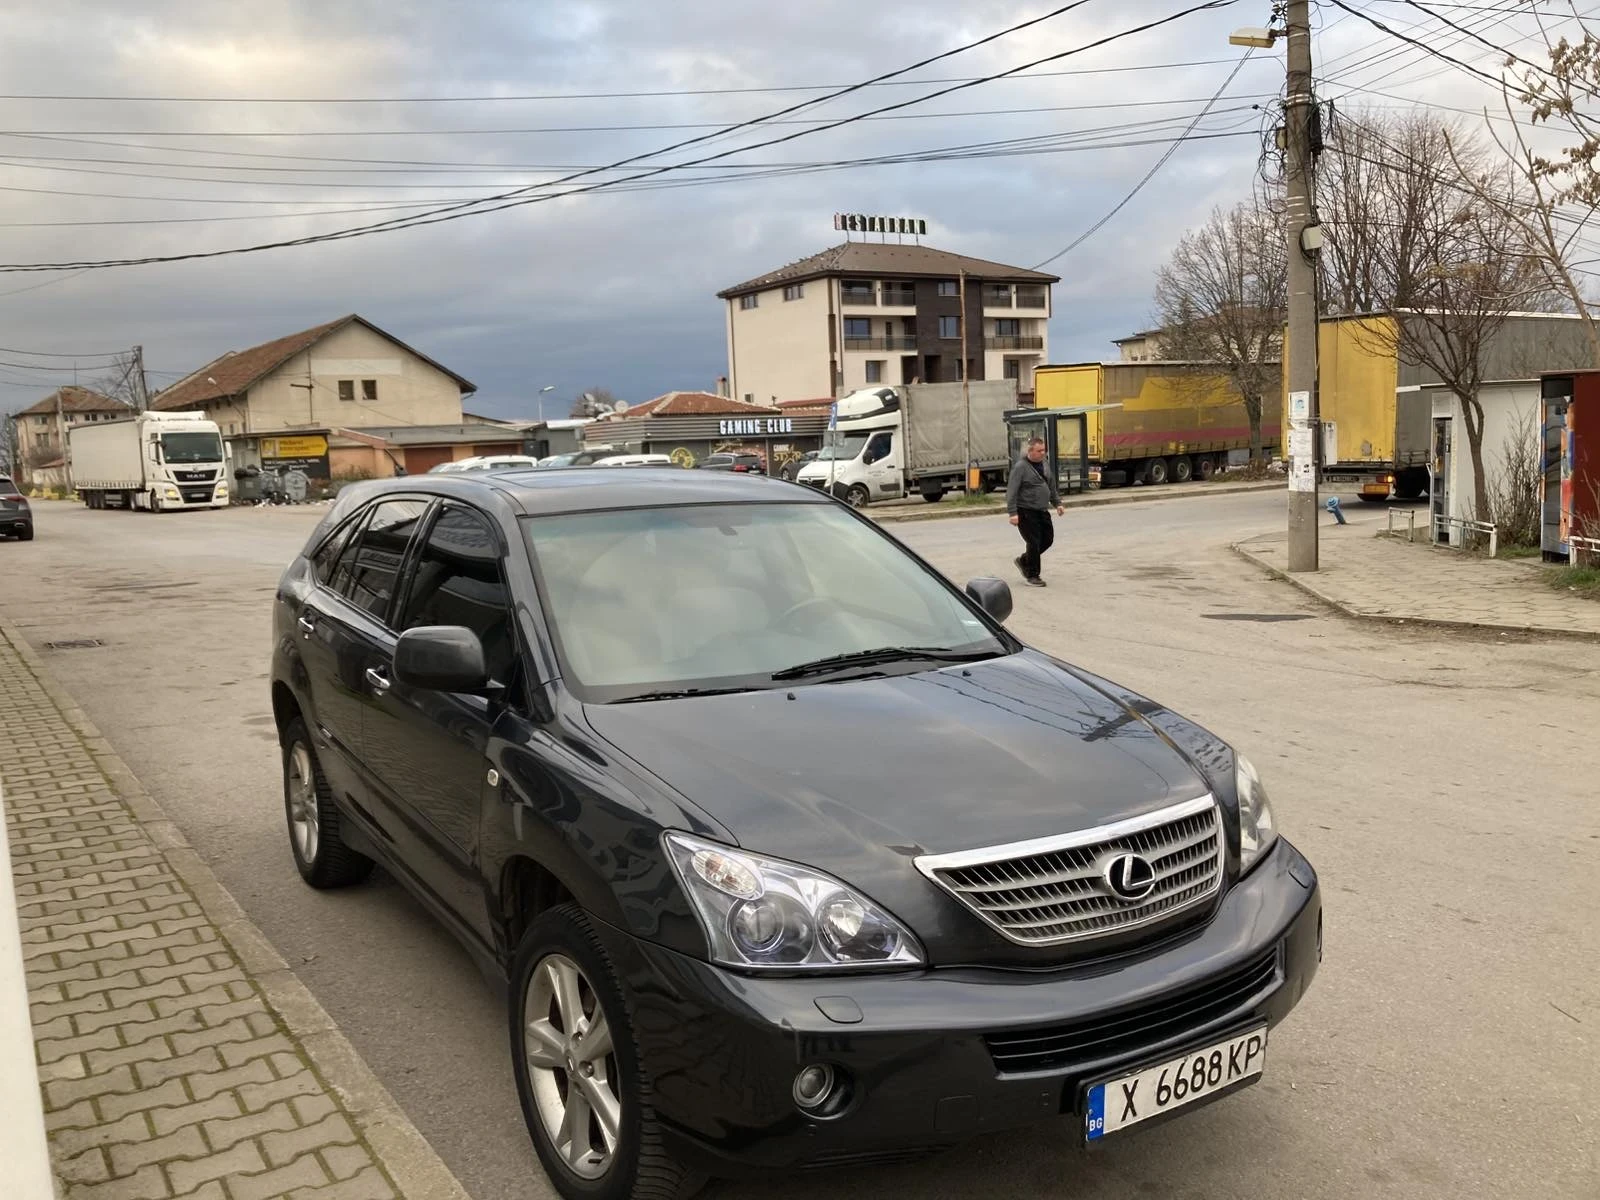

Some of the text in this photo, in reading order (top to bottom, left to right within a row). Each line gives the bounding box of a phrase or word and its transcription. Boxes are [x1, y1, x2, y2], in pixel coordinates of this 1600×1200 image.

[833, 213, 928, 235] RESTAURANT
[720, 418, 792, 435] GAMING CLUB
[1089, 1117, 1103, 1132] BG
